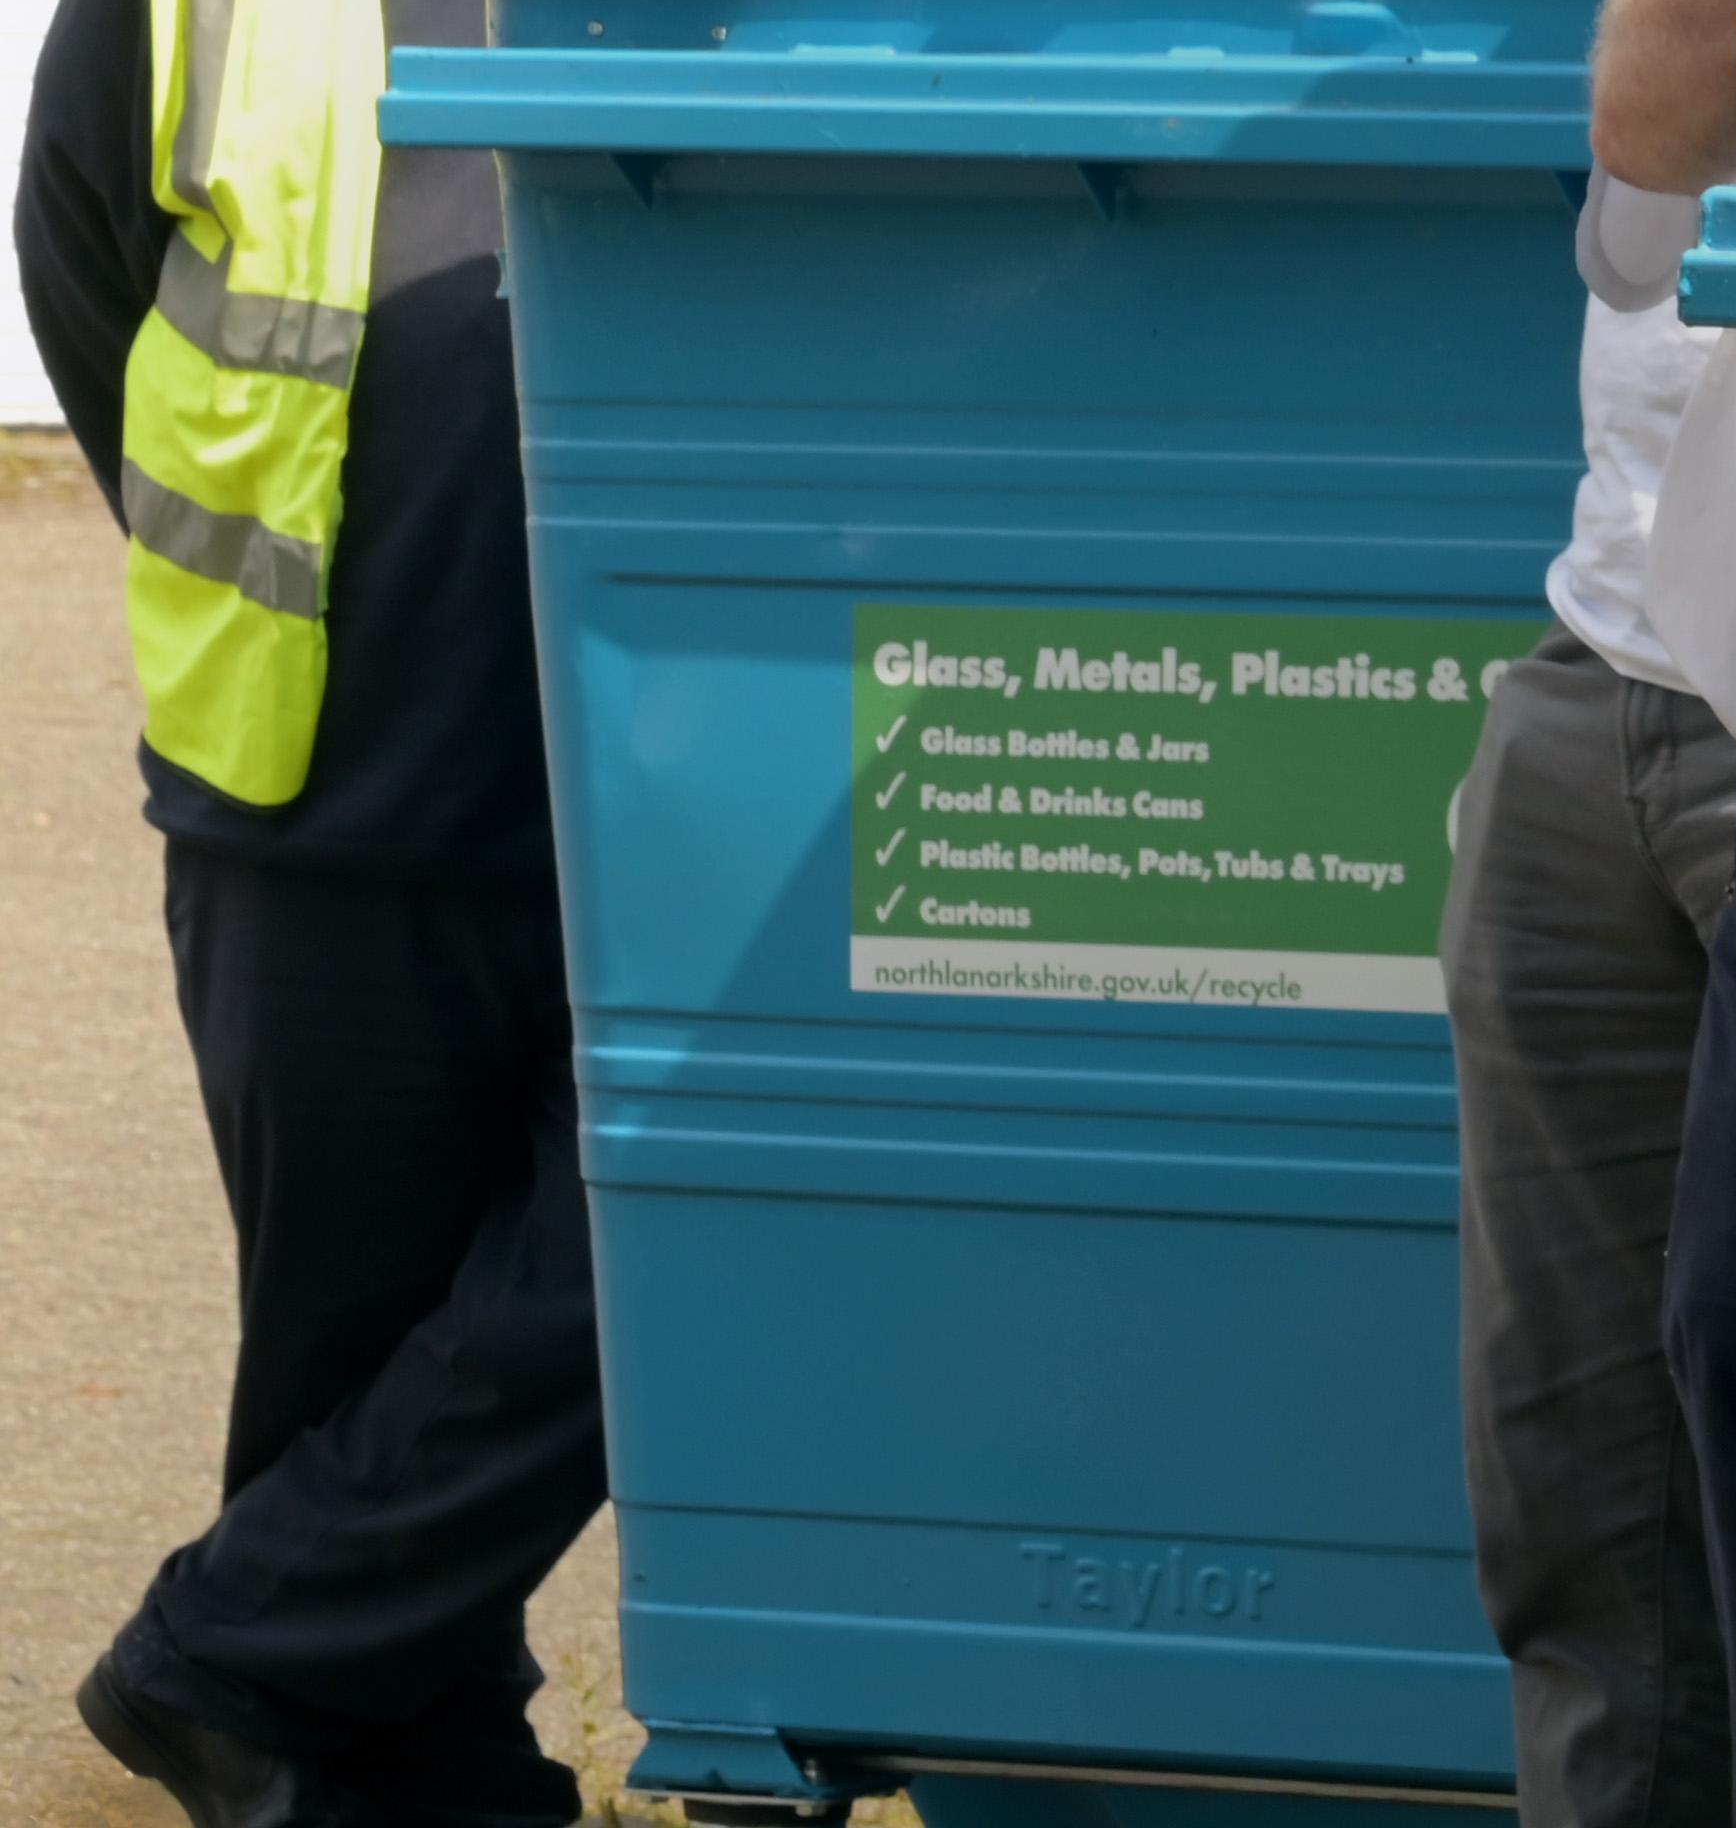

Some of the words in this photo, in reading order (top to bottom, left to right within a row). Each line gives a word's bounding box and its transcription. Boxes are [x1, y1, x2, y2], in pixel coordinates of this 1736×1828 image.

[874, 641, 1020, 697] Glass,
[1034, 648, 1216, 703] Metals,
[1232, 650, 1416, 700] Plastics
[1427, 658, 1468, 701] &
[921, 726, 1001, 756] Glass
[1008, 730, 1109, 759] Bottles
[1116, 733, 1140, 760] &
[1147, 735, 1209, 762] Jars
[921, 784, 992, 812] Food
[998, 787, 1022, 813] &
[1030, 788, 1126, 817] Drinks
[1133, 791, 1203, 819] Cans
[921, 840, 1014, 870] Plastic
[1021, 844, 1131, 879] Bottles,
[1139, 848, 1211, 881] Pots,
[1215, 850, 1284, 879] Tubs
[1290, 853, 1314, 880] &
[1322, 855, 1404, 890] Trays
[920, 898, 1030, 927] Cartons
[874, 959, 1302, 1008] northlanarkshire.gov.uk/recycle
[1018, 1541, 1275, 1628] Taylor
